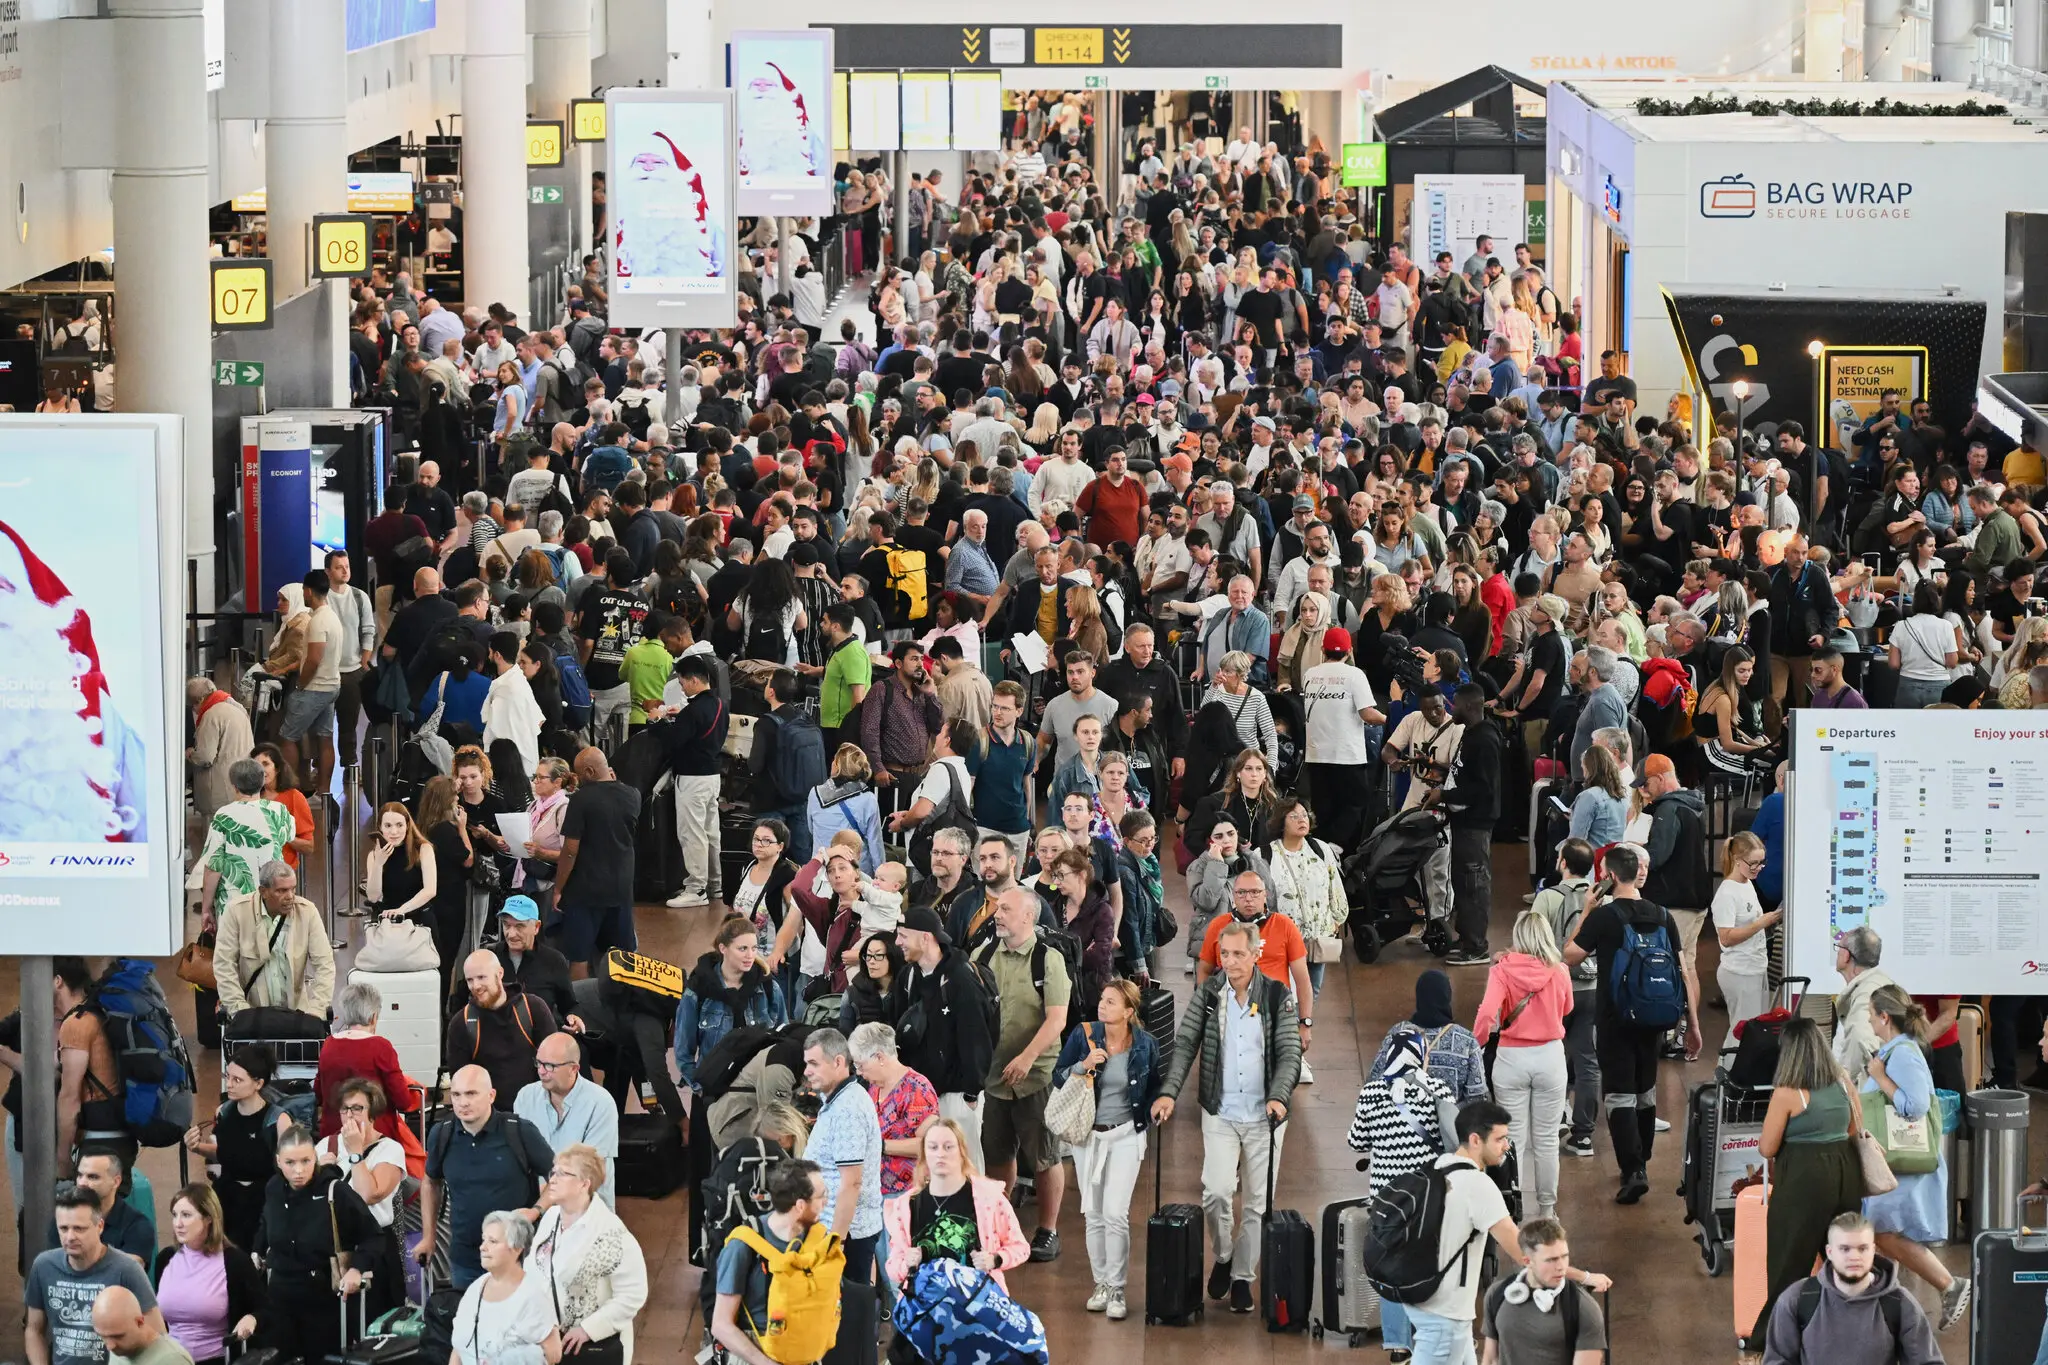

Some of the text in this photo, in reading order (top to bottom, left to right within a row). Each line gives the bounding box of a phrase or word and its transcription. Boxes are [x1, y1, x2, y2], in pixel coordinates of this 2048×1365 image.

[0, 26, 18, 60] irport
[1046, 33, 1093, 42] CHECK-IN
[1048, 47, 1093, 61] 11-14
[1530, 56, 1678, 70] STELLA ARTOIS
[583, 116, 602, 133] 10
[530, 139, 555, 158] 09
[1767, 182, 1913, 205] BAG WRAP
[1767, 208, 1911, 219] SECURE LUGGAGE
[327, 240, 359, 264] 08
[222, 288, 258, 315] 07
[1837, 366, 1894, 375] NEED CASH
[1837, 377, 1880, 386] AT YOUR
[617, 599, 632, 607] the
[1829, 727, 1896, 740] Departures
[1974, 728, 2006, 741] Enjoy
[2009, 730, 2036, 741] your
[49, 855, 136, 867] FINNAIR
[636, 959, 681, 980] NORTH
[636, 968, 662, 982] THE
[48, 1285, 77, 1300] FINEST
